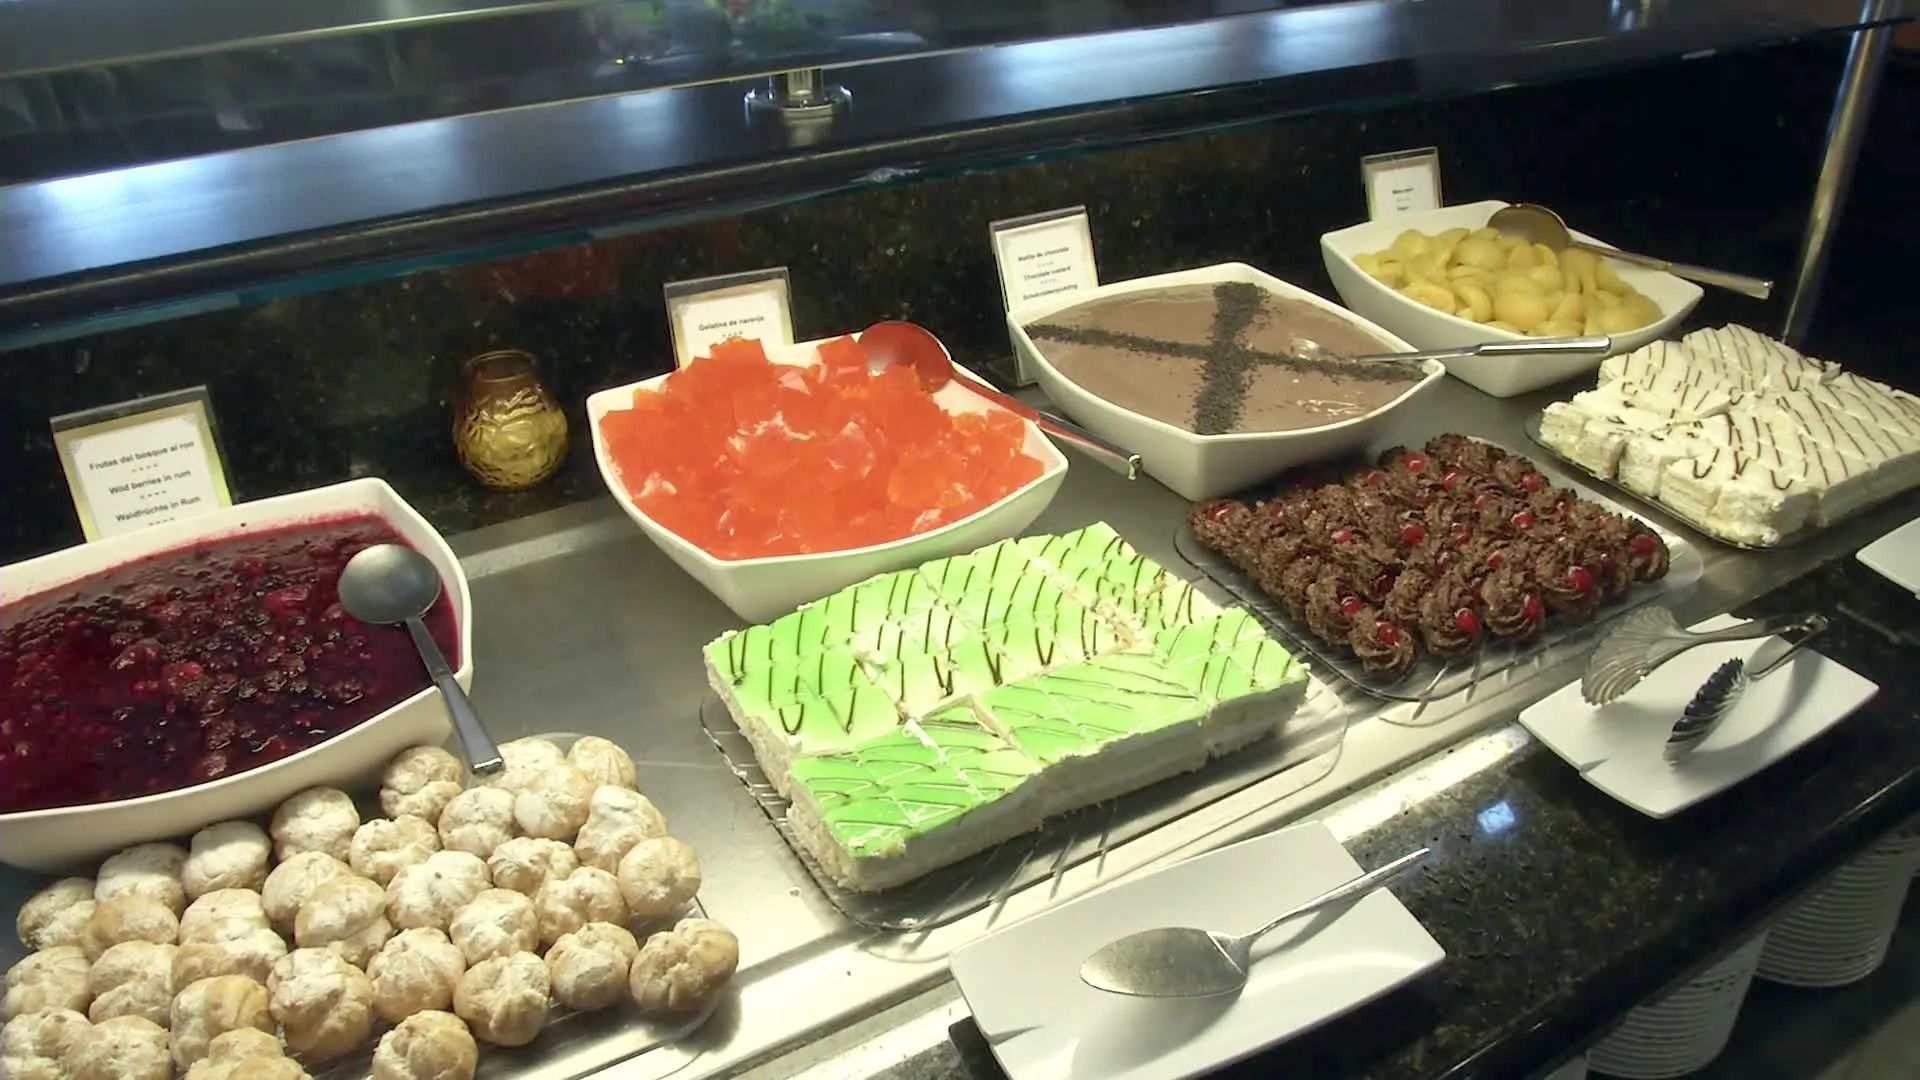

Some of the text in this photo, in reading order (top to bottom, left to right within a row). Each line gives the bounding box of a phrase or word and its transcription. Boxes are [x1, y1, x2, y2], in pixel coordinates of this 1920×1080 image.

[1023, 271, 1050, 281] Chocolate
[698, 321, 727, 331] Gelatina
[739, 315, 764, 324] naranja
[89, 459, 118, 470] Frutas
[119, 454, 134, 464] del
[134, 447, 168, 460] bosque
[109, 483, 130, 495] Wild
[131, 478, 161, 490] berries
[173, 470, 192, 479] rum
[170, 501, 179, 509] in
[180, 496, 201, 506] Rum
